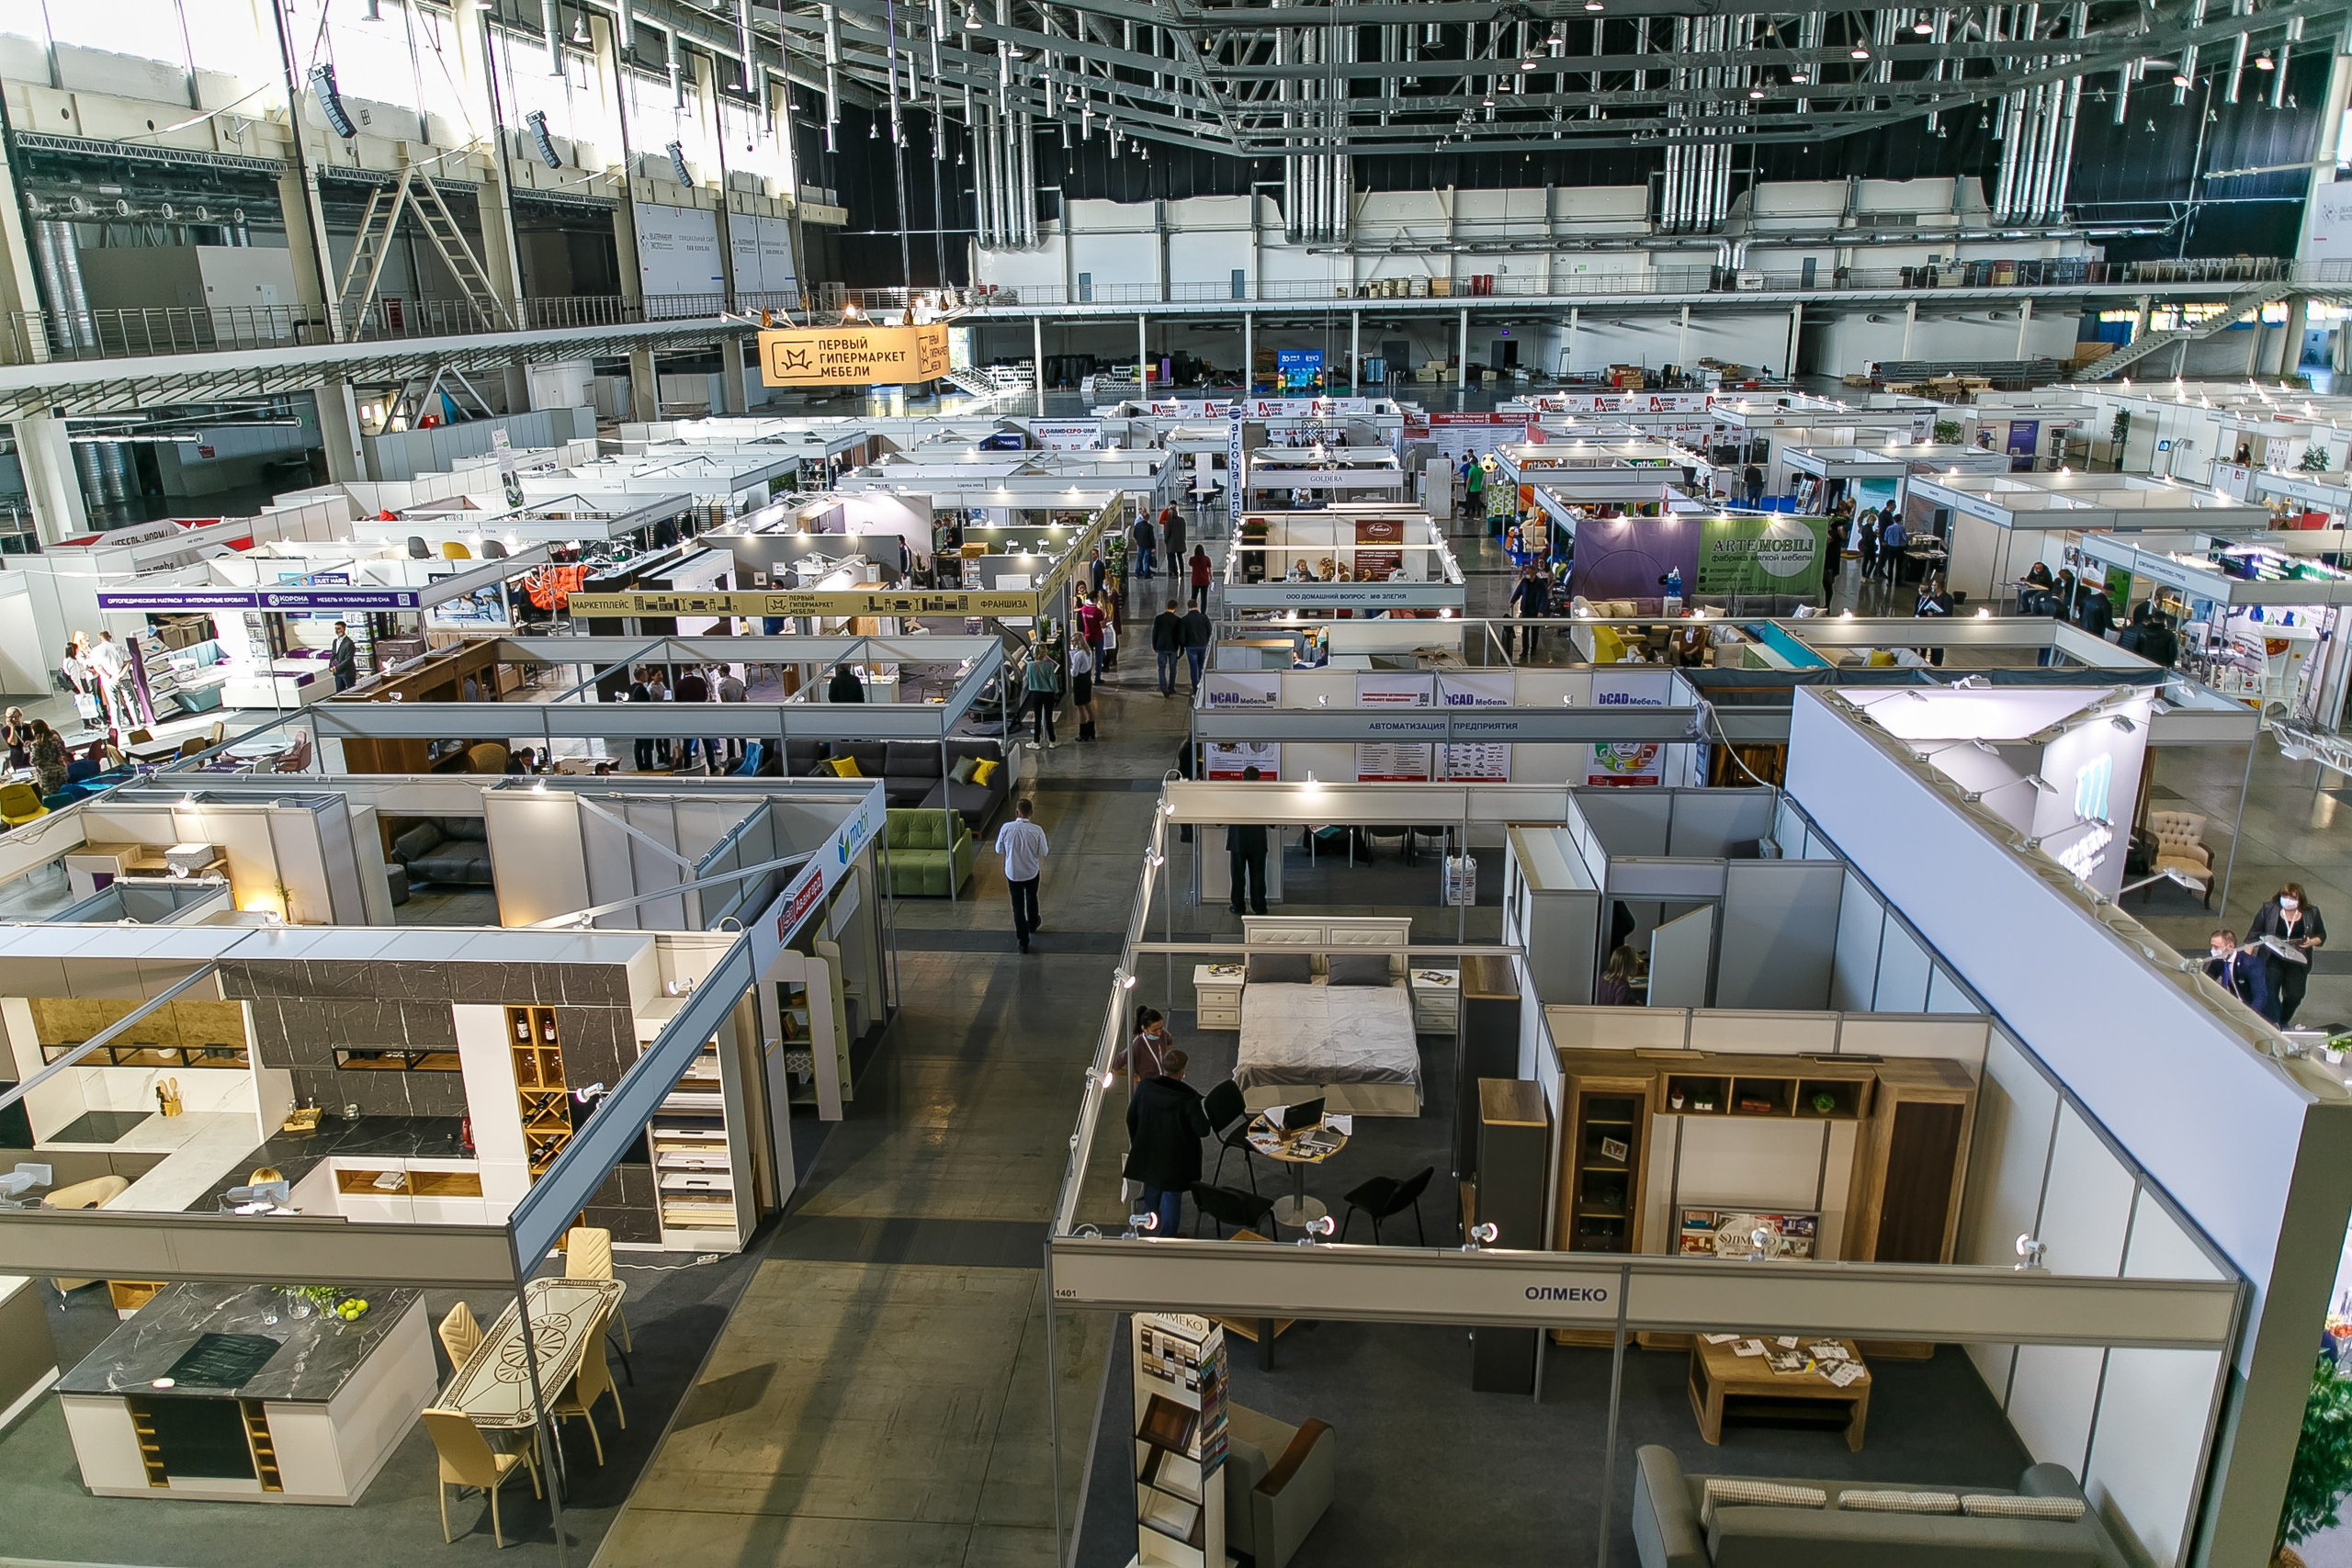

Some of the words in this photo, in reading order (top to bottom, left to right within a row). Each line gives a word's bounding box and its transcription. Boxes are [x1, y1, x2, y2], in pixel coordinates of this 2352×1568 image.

[818, 336, 868, 351] ПЕРВЫЙ
[820, 351, 906, 365] ГИПЕРМАРКЕТ
[821, 365, 870, 378] МЕБЕЛИ
[1231, 423, 1240, 519] arcobaleno
[1711, 554, 1748, 563] фабрика
[1750, 553, 1780, 561] мягкой
[1781, 553, 1814, 561] мебели
[1301, 592, 1339, 601] ДОМАШНИЙ
[572, 600, 629, 610] МАРКЕТПЛЕЙС
[980, 600, 1027, 609] ФРАНШИЗА
[1210, 692, 1239, 704] bCAD
[1599, 694, 1629, 705] bCAD
[1369, 723, 1445, 731] АВТОМАТИЗАЦИЯ
[1453, 723, 1518, 731] ПРЕДПРИЯТИЯ
[1718, 1233, 1777, 1247] ОЛМО
[1056, 1289, 1077, 1297] 1401
[1524, 1286, 1608, 1302] ОЛМЕКО
[1156, 1313, 1203, 1332] ЛМЕКО
